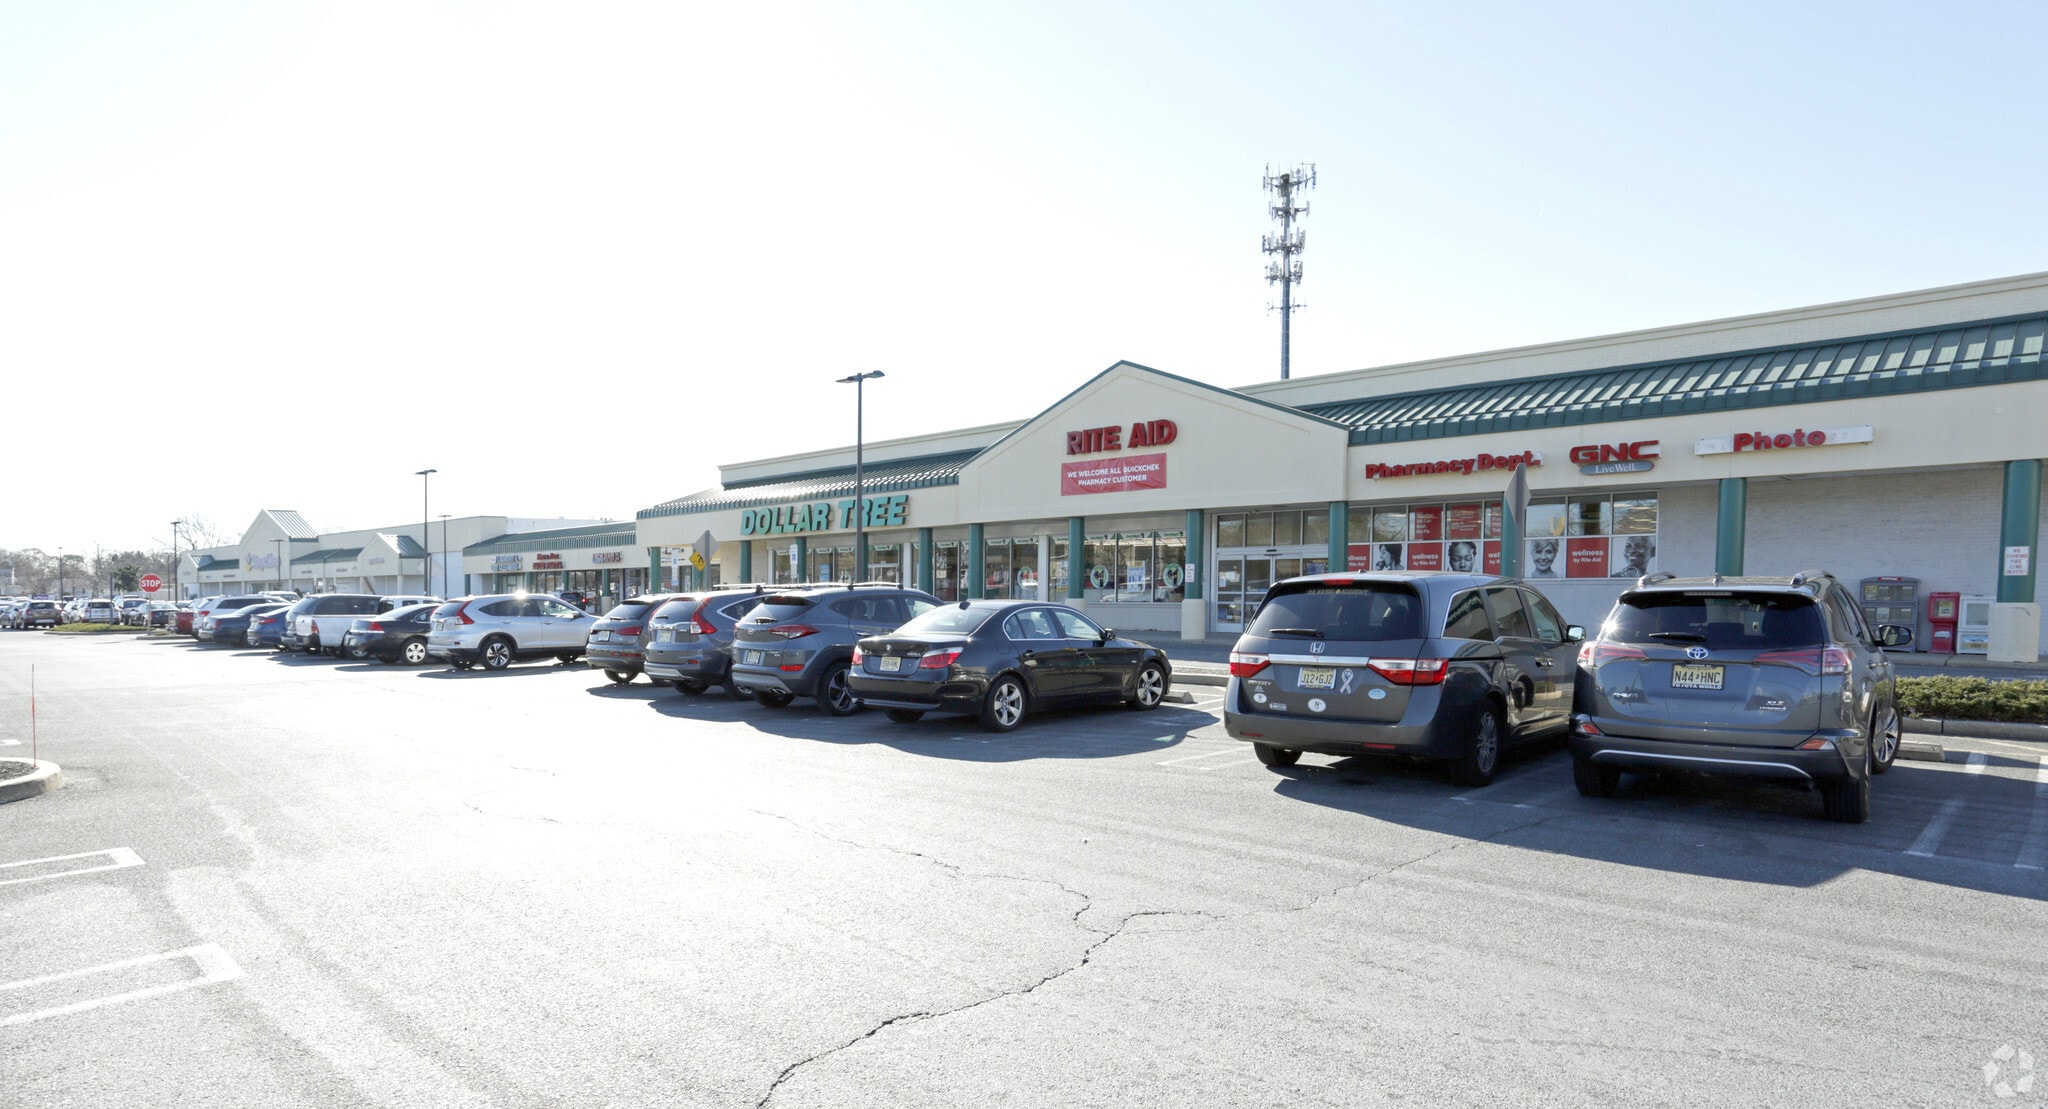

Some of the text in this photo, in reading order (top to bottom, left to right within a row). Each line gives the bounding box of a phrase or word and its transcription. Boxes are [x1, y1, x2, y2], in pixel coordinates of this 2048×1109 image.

[1066, 419, 1178, 455] RITE AID
[1733, 428, 1826, 452] Photo
[1569, 439, 1660, 464] GNC
[1078, 468, 1108, 477] WELCOME
[1109, 466, 1121, 475] ALL
[1123, 464, 1159, 474] QUICKCHEK
[1365, 450, 1541, 480] Pharmacy Dept.
[1078, 474, 1147, 486] PHARMACY CUSTOMER
[740, 495, 909, 536] DOLLAR TREE
[141, 579, 161, 588] STOP
